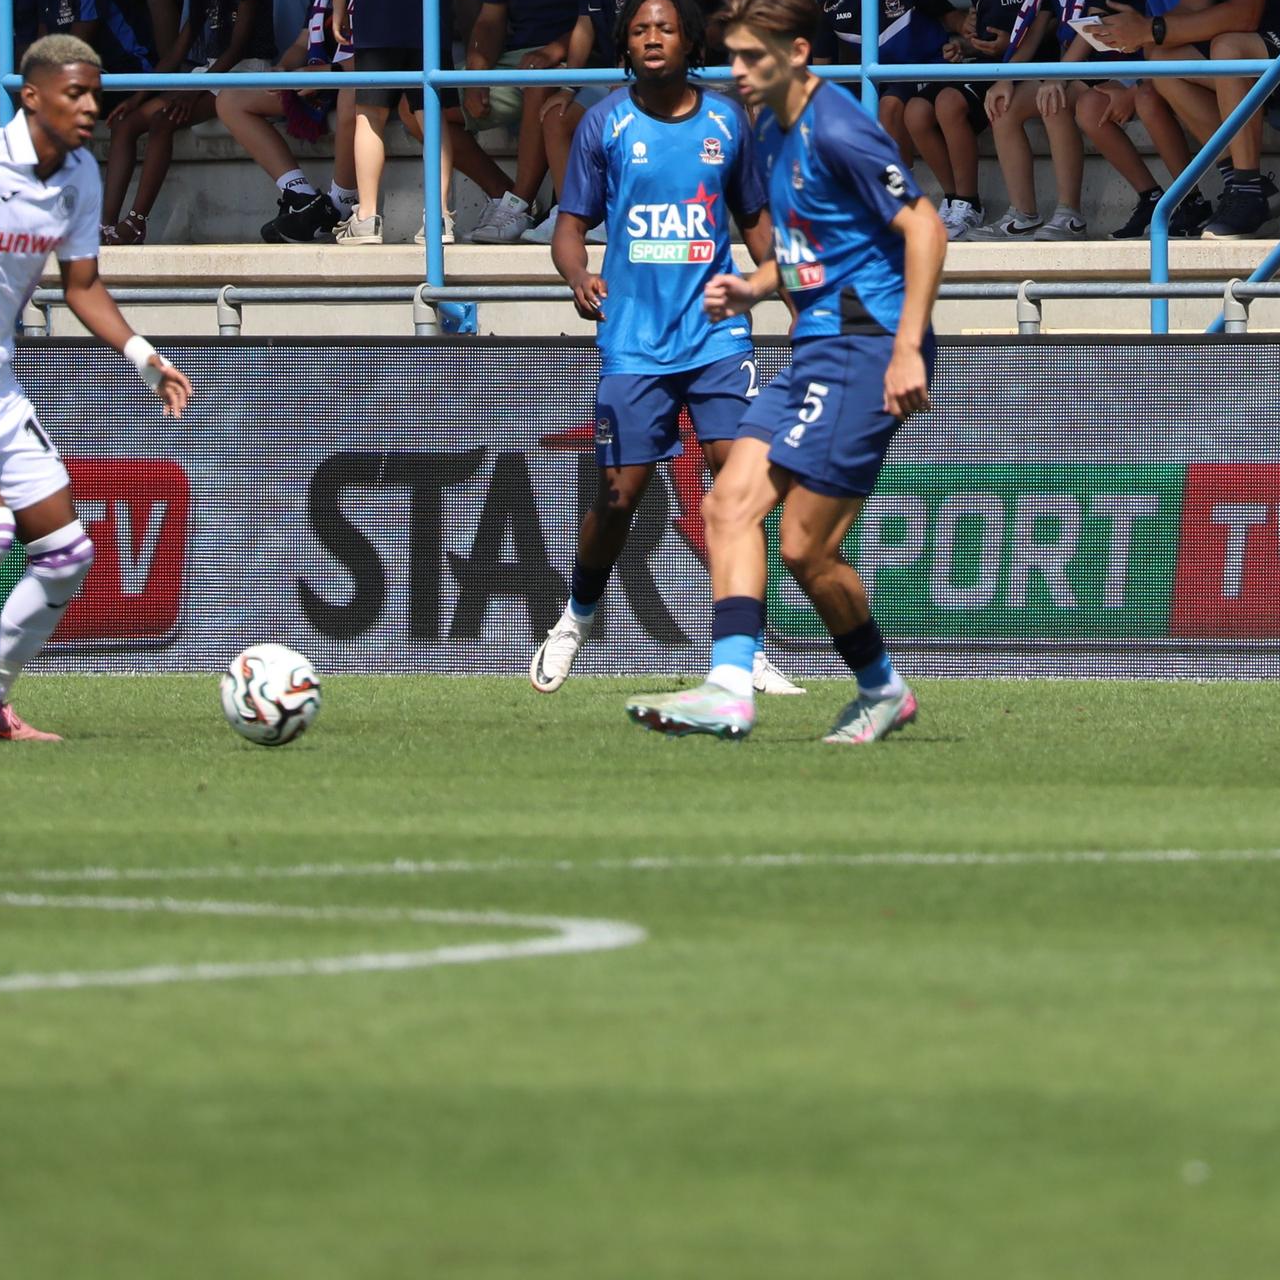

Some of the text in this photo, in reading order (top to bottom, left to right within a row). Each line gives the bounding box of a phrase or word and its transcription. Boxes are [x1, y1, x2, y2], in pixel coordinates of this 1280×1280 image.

[835, 11, 853, 21] JAKO
[627, 203, 710, 238] STAR
[632, 243, 712, 260] SPORT TV
[739, 359, 759, 397] 2
[798, 382, 829, 424] 5
[780, 493, 1161, 611] PORT
